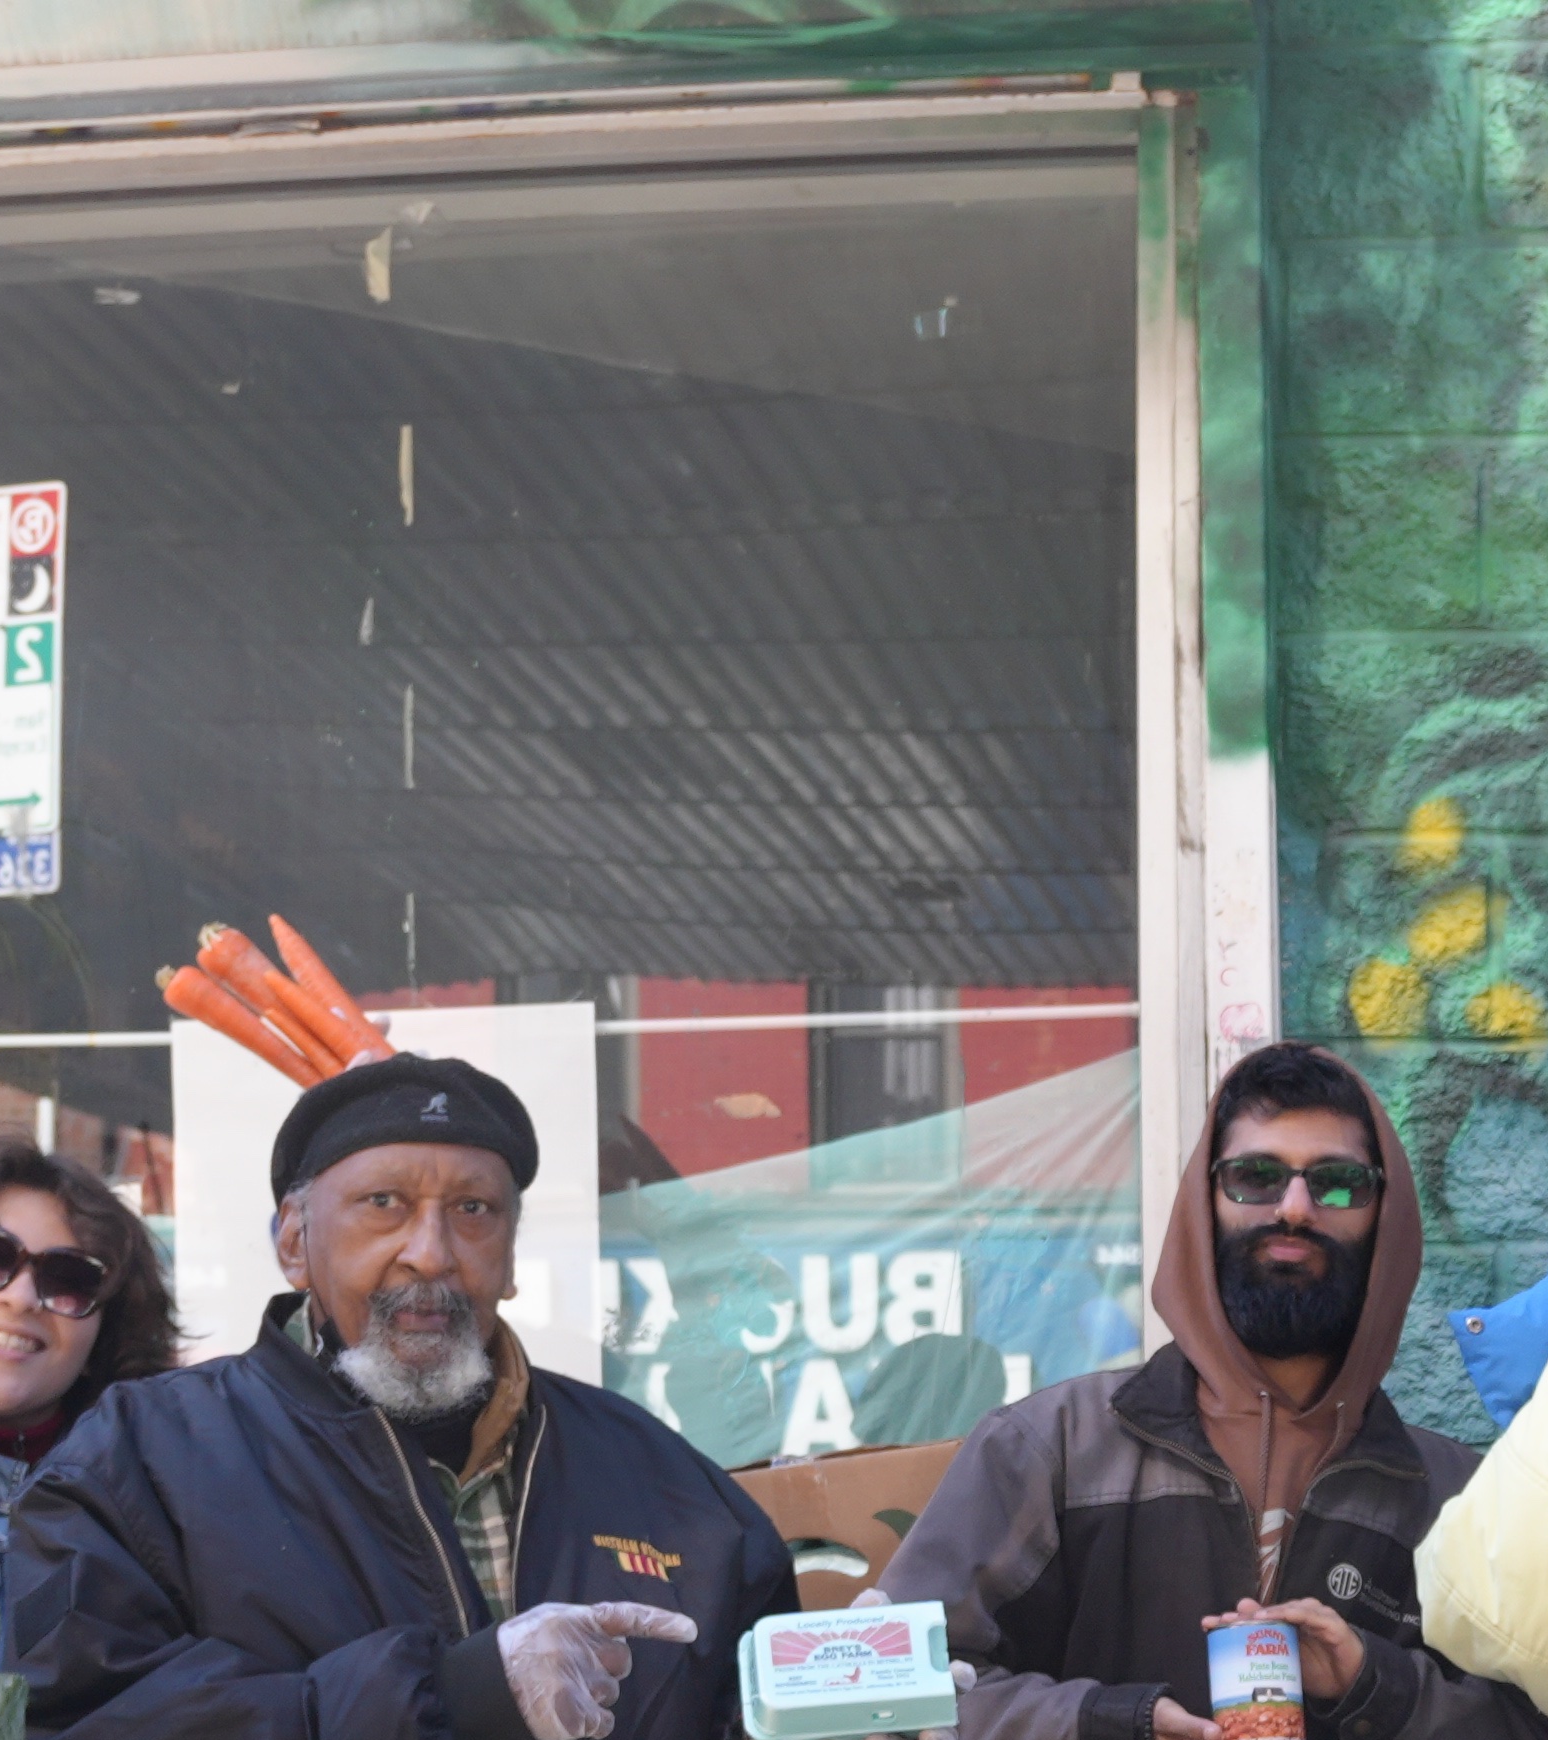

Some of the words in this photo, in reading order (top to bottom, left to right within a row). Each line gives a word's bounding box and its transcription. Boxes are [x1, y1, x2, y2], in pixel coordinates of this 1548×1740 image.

[797, 1617, 833, 1630] Locally
[836, 1615, 885, 1627] Produced
[1247, 1628, 1288, 1642] SUNNY
[1246, 1644, 1290, 1657] FARM
